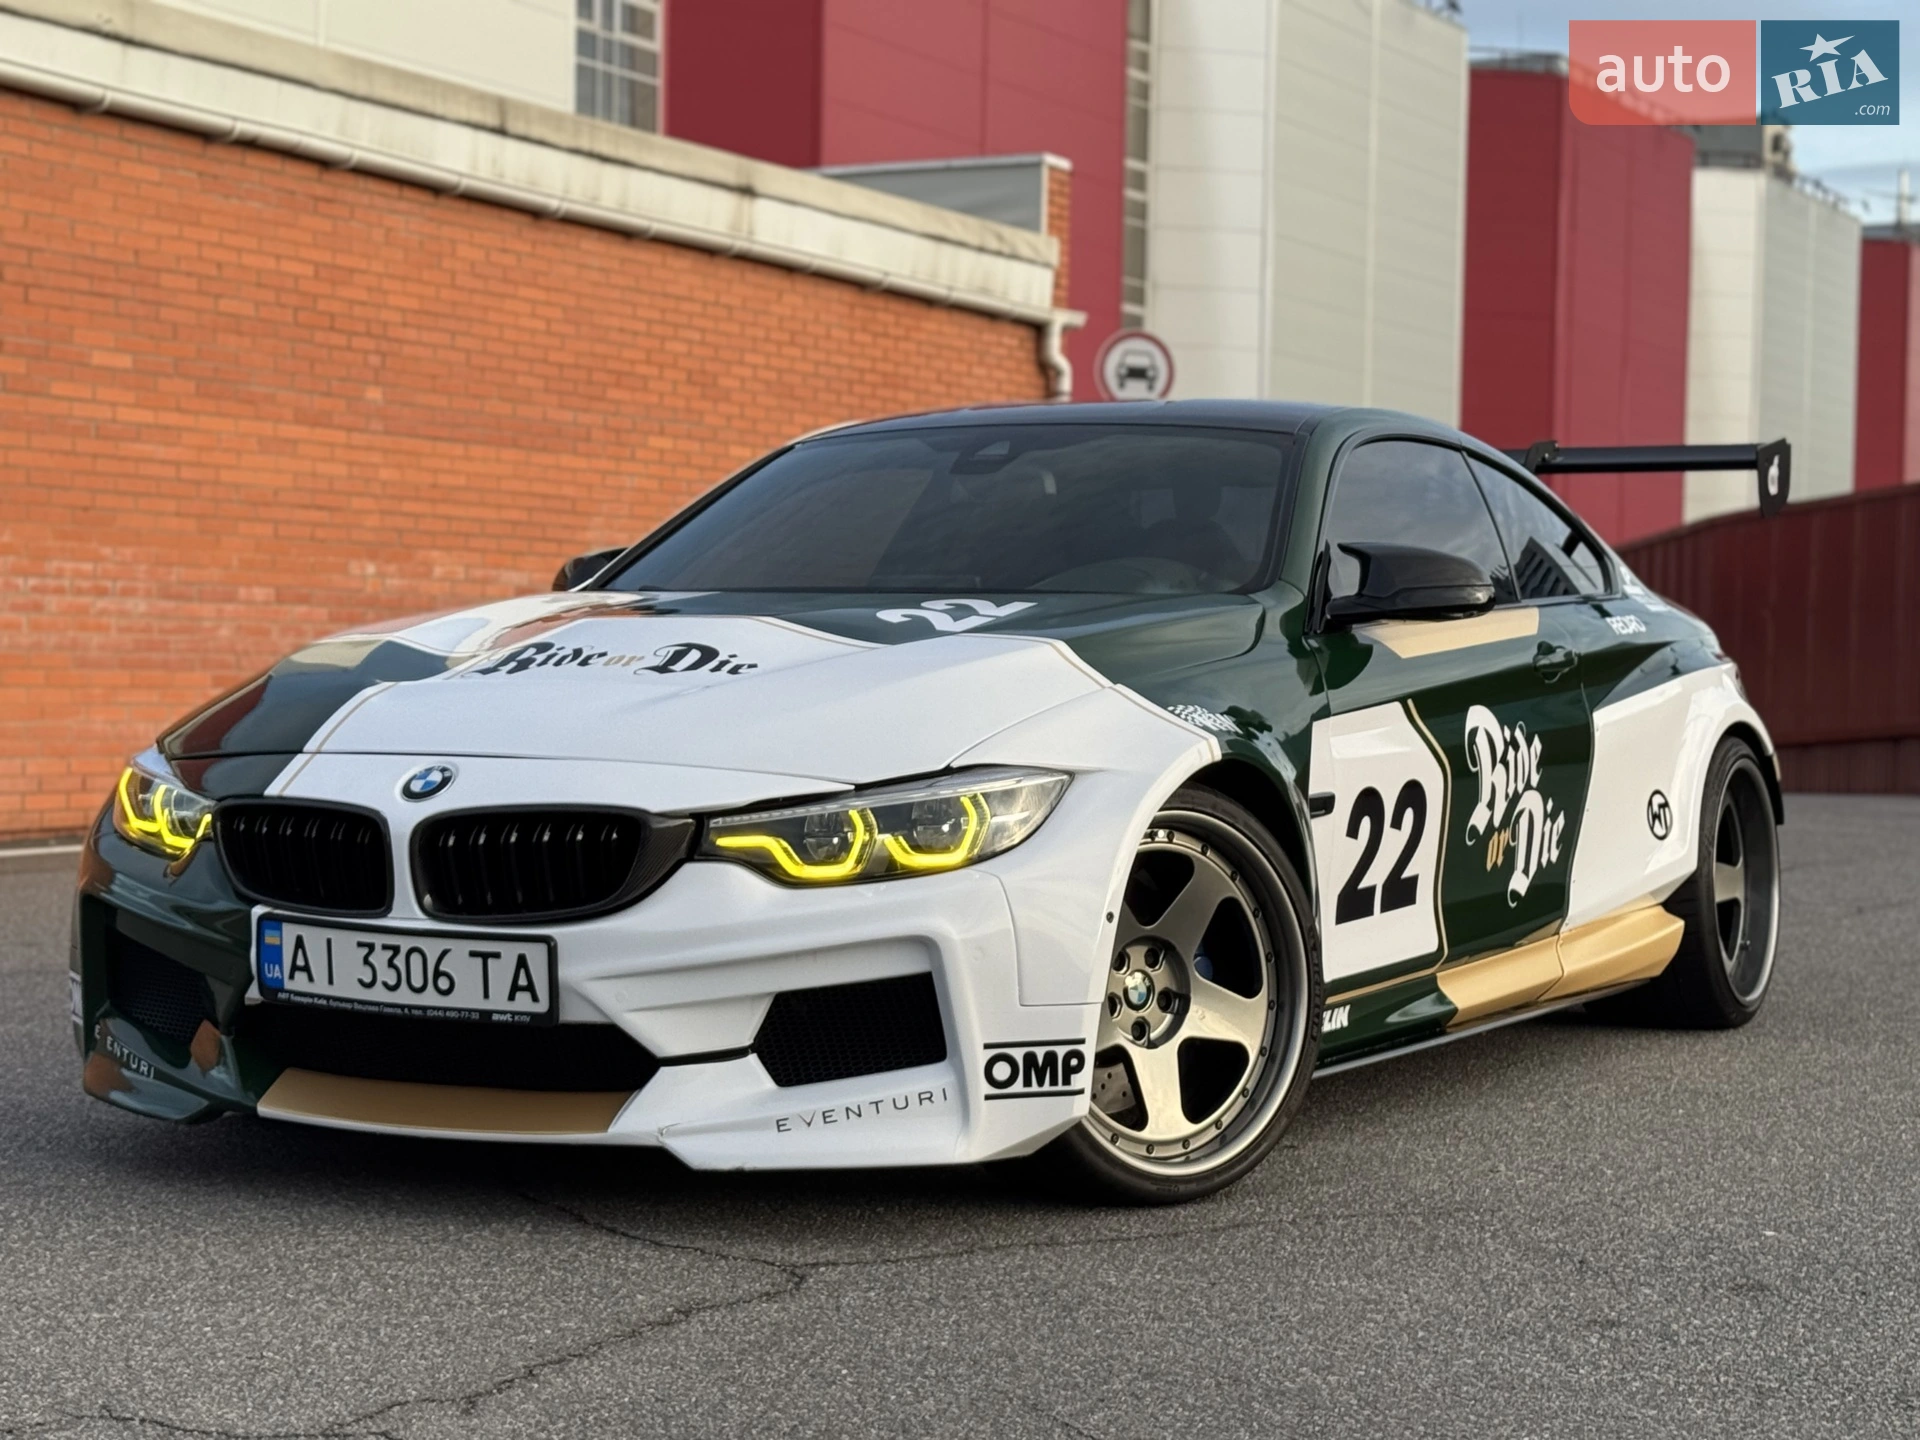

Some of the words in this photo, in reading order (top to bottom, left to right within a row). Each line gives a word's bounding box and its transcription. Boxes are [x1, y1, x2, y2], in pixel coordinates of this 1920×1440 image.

[876, 598, 1039, 632] 22
[466, 641, 609, 676] Ride
[601, 654, 645, 668] or
[633, 642, 759, 676] Die
[1464, 704, 1544, 846] Ride
[1335, 778, 1428, 927] 22
[1486, 826, 1510, 872] or
[1507, 789, 1565, 908] Die
[264, 962, 283, 981] UA
[356, 940, 456, 997] 3306
[468, 950, 541, 1004] TA
[492, 1012, 513, 1021] awt
[984, 1049, 1086, 1090] OMP
[775, 1088, 948, 1134] EVENTURI
